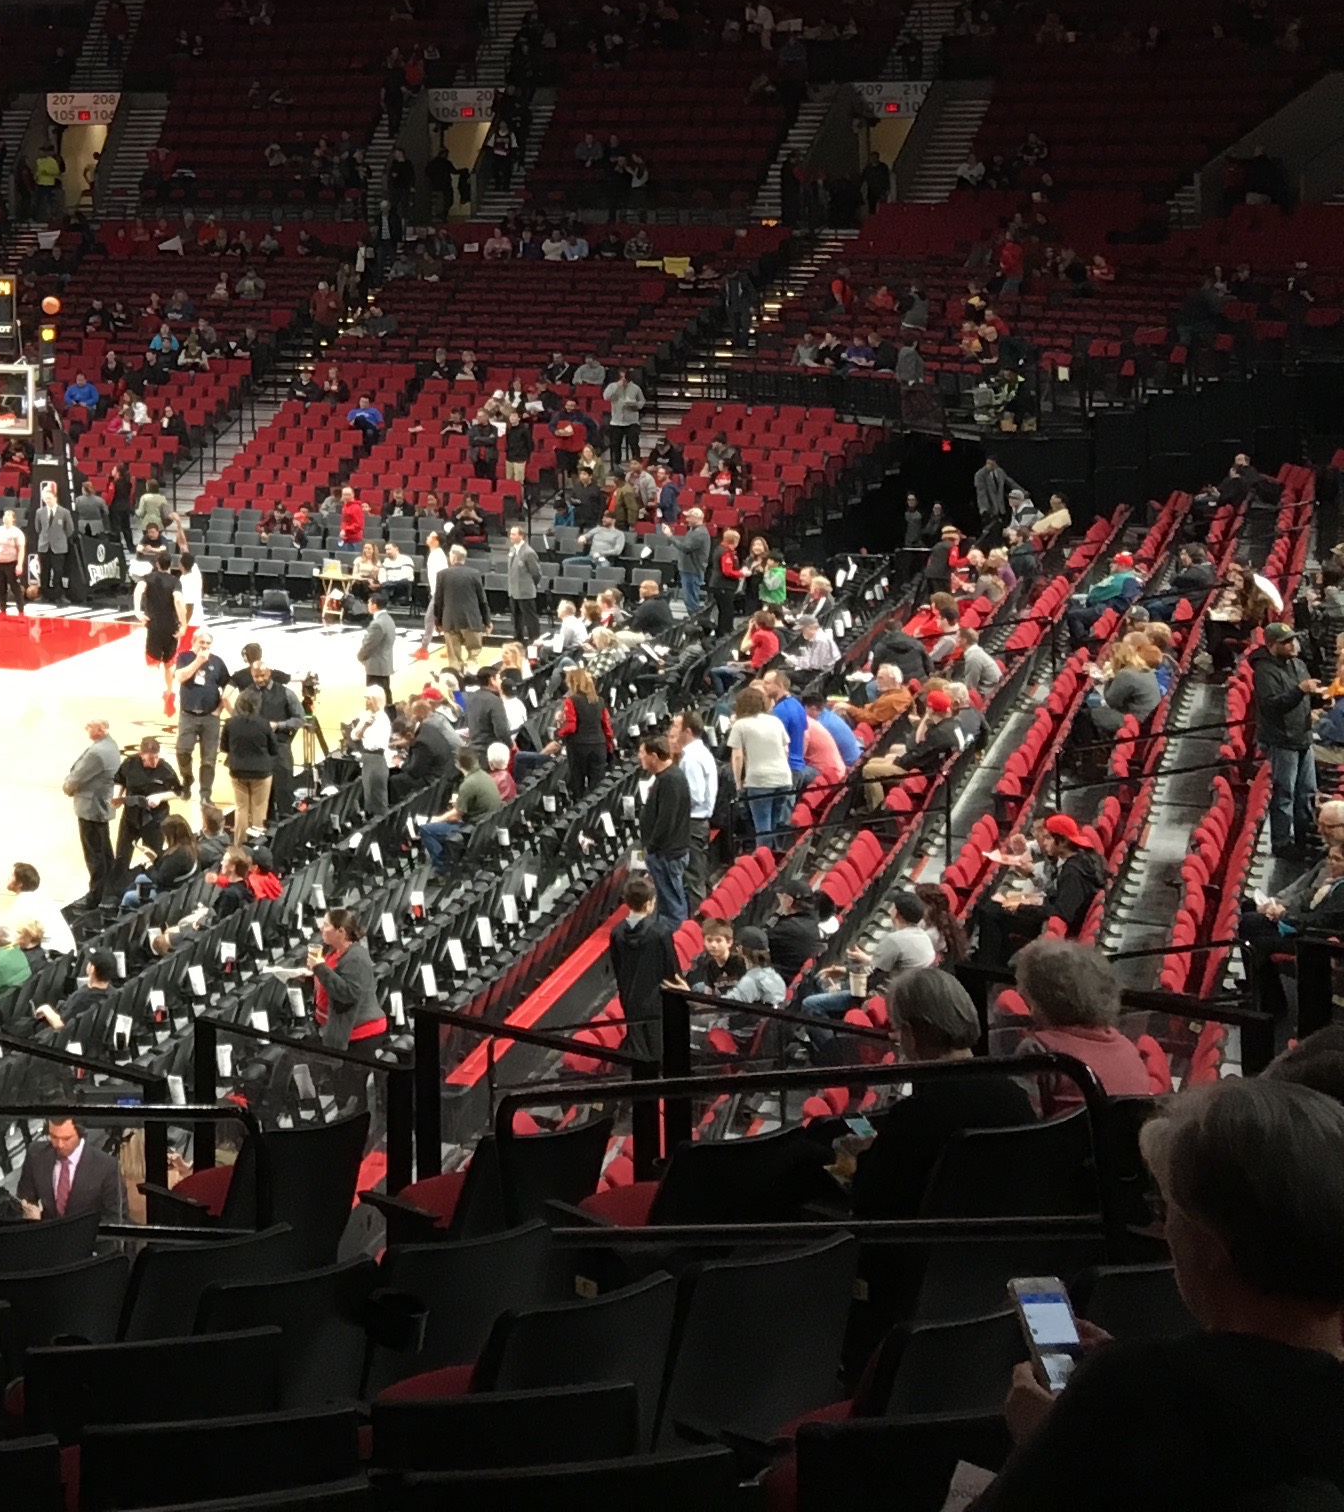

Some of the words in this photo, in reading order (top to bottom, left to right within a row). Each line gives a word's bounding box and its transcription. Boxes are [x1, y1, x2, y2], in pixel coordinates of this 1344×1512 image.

[52, 94, 75, 106] 207
[92, 94, 116, 105] 208
[433, 90, 458, 102] 208
[475, 90, 492, 101] 20
[53, 110, 75, 121] 105
